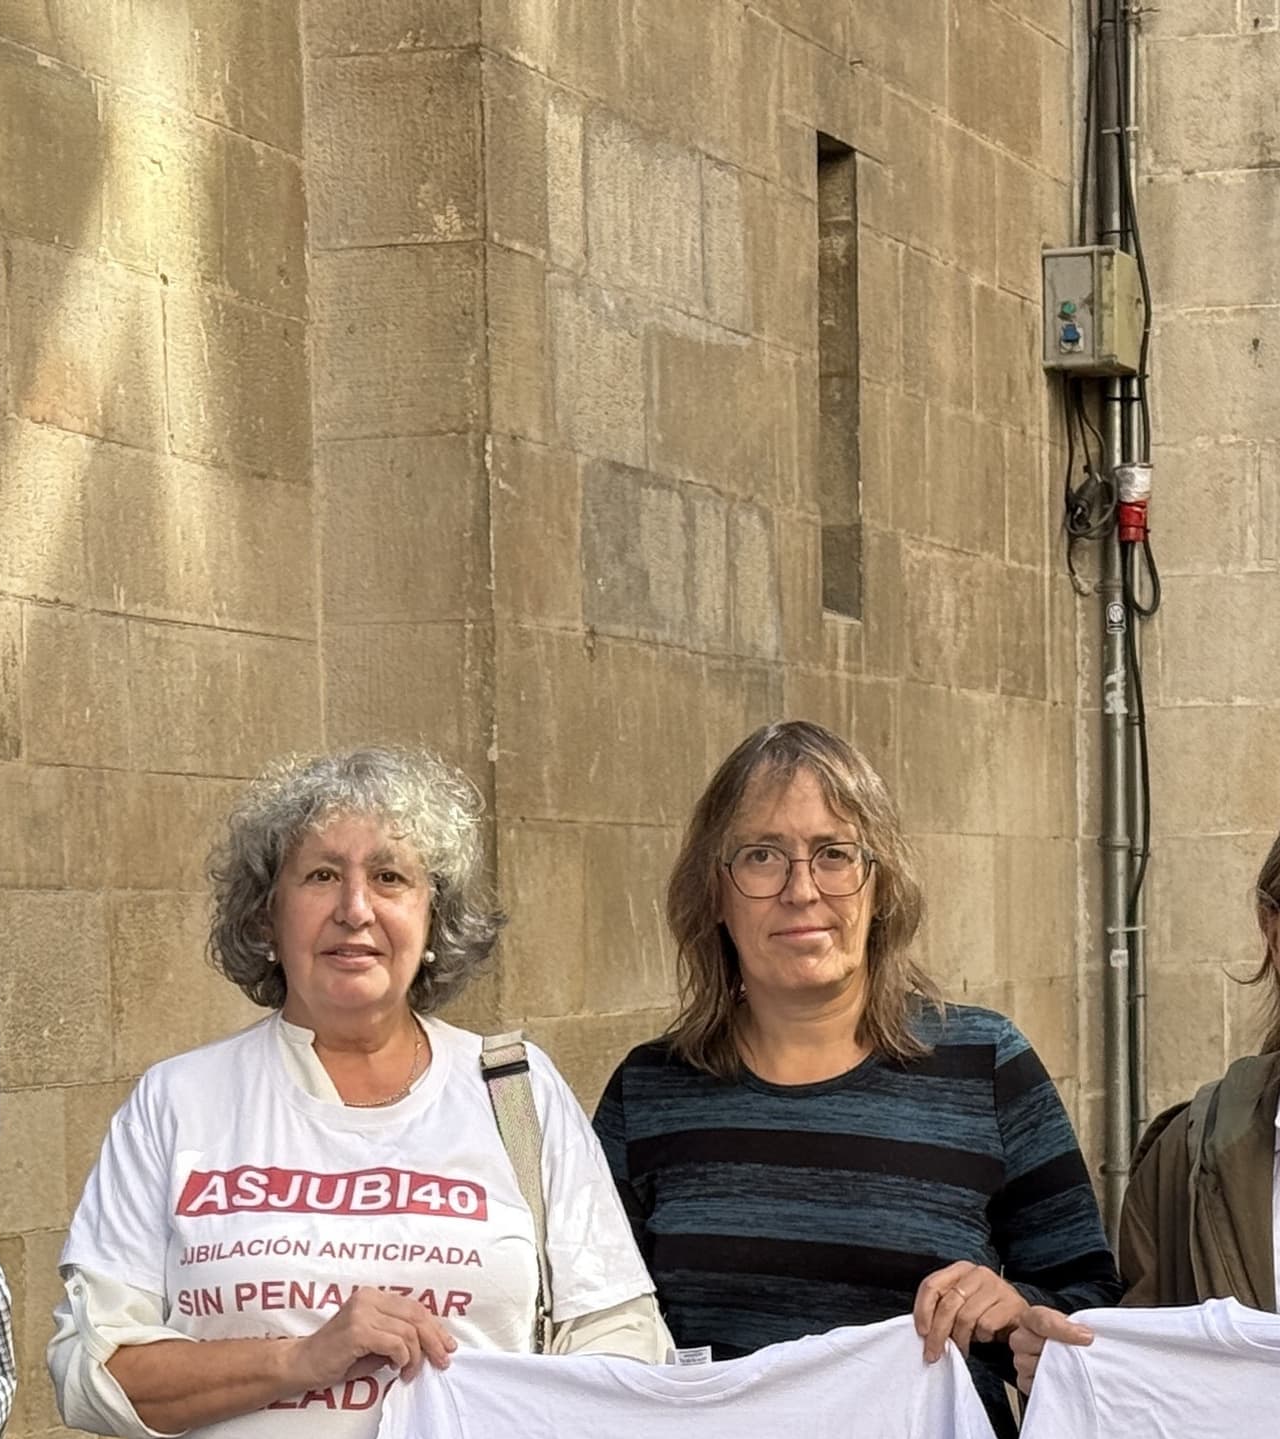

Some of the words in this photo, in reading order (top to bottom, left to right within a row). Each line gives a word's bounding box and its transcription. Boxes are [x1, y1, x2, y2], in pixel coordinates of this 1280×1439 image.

[186, 1169, 478, 1214] ASJUBI40
[319, 1241, 483, 1267] ANTICIPADA
[179, 1286, 224, 1317] SIN
